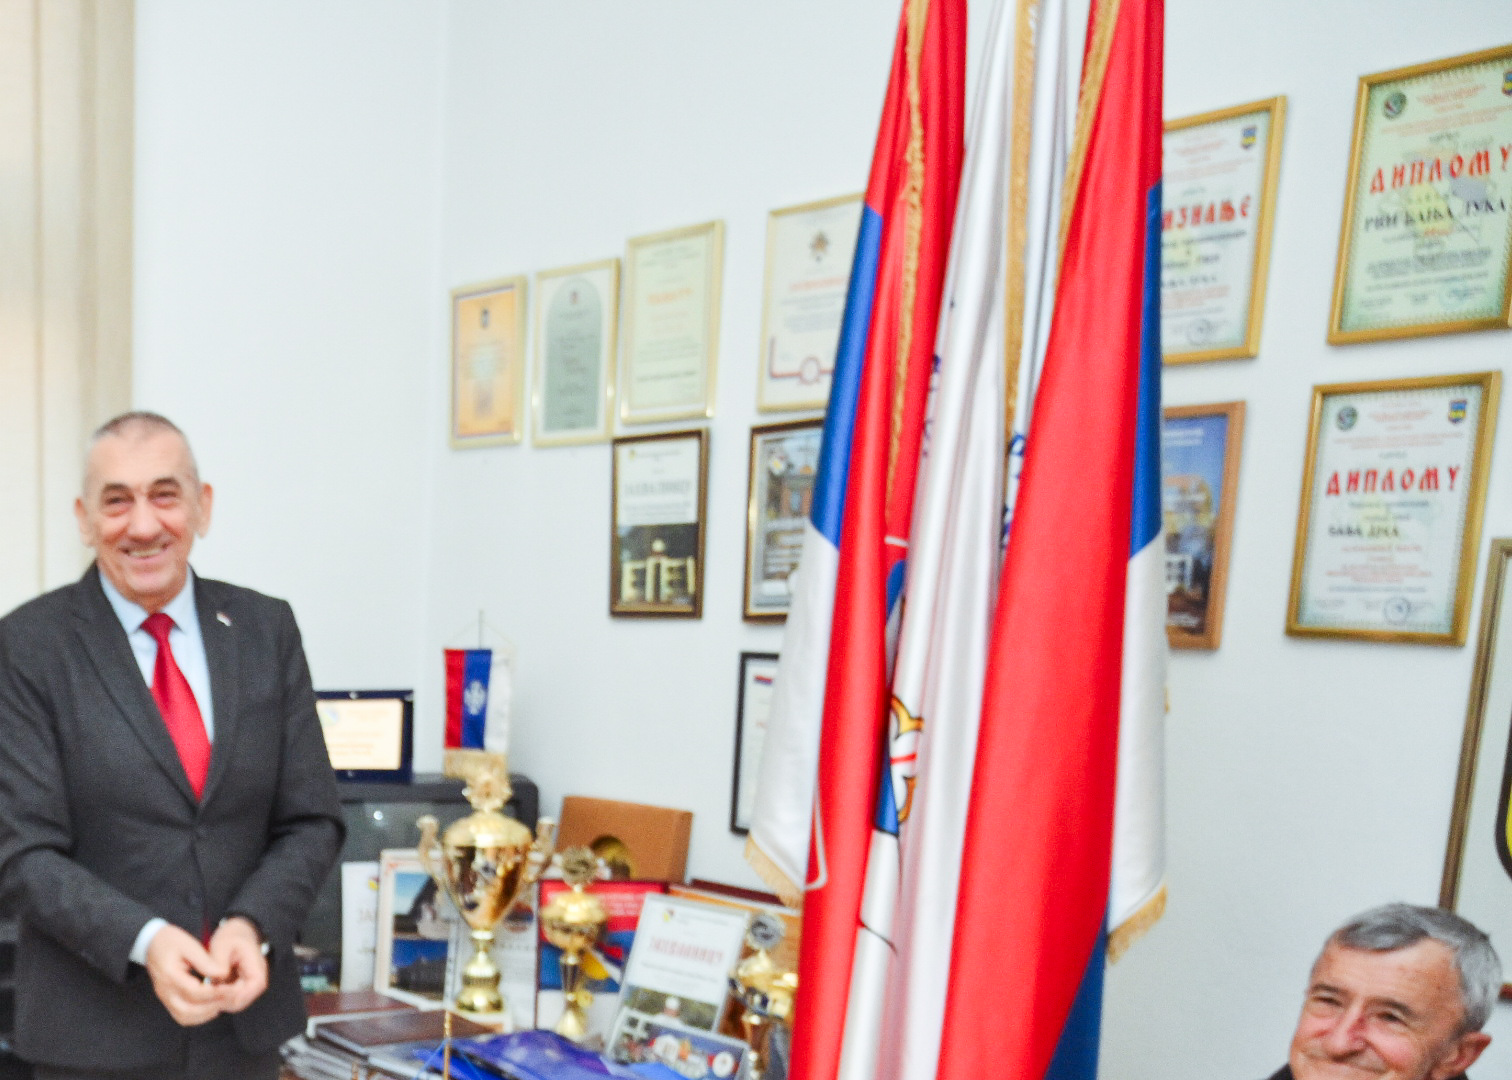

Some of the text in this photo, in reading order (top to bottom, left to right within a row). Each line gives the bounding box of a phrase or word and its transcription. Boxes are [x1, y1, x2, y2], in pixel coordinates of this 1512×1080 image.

[1369, 143, 1512, 195] ДИПЛОМУ
[1162, 195, 1251, 232] ИЗНАЊЕ
[1326, 466, 1460, 496] ДИПЛОМУ
